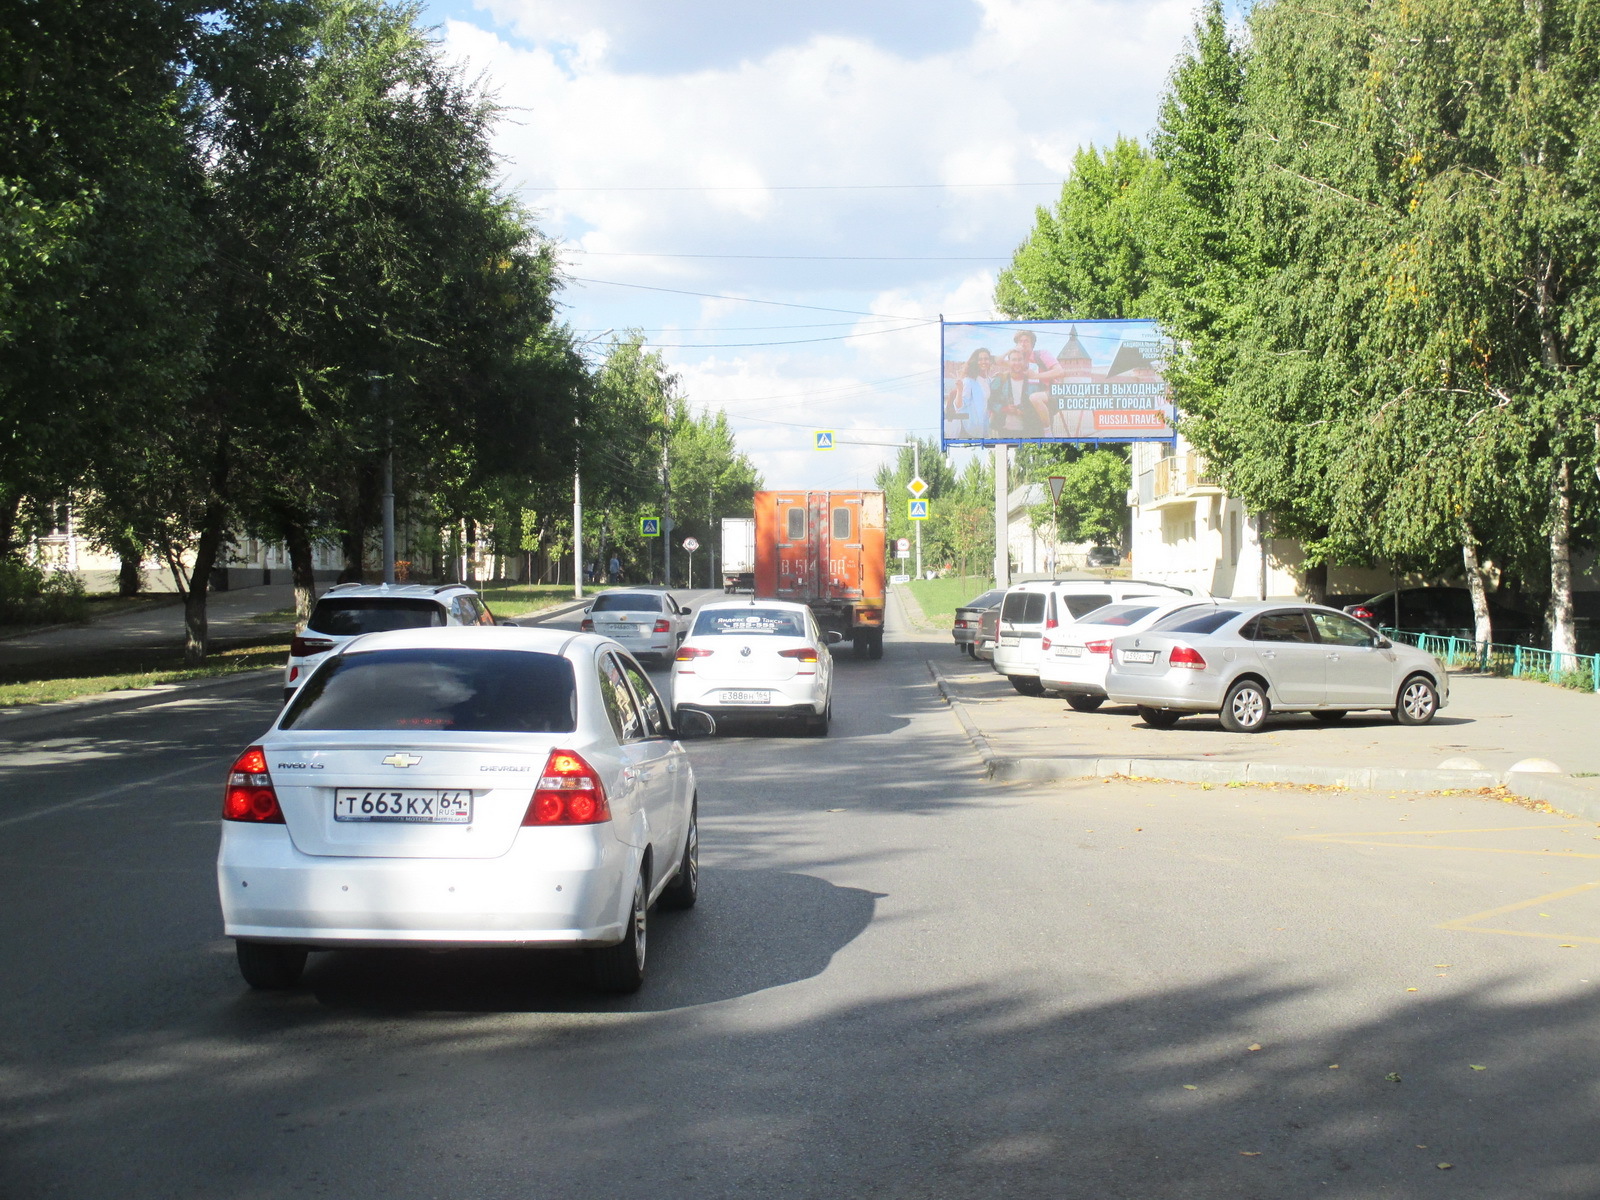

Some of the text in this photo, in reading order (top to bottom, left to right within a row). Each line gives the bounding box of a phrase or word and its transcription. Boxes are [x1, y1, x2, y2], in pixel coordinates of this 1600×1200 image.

[1051, 383, 1165, 396] ВЫХОДИТЕ В ВЫХОДНЫЕ
[1058, 397, 1152, 410] В СОСЕДНИЕ ГОРОДА
[310, 762, 325, 770] LS
[440, 792, 462, 809] 64
